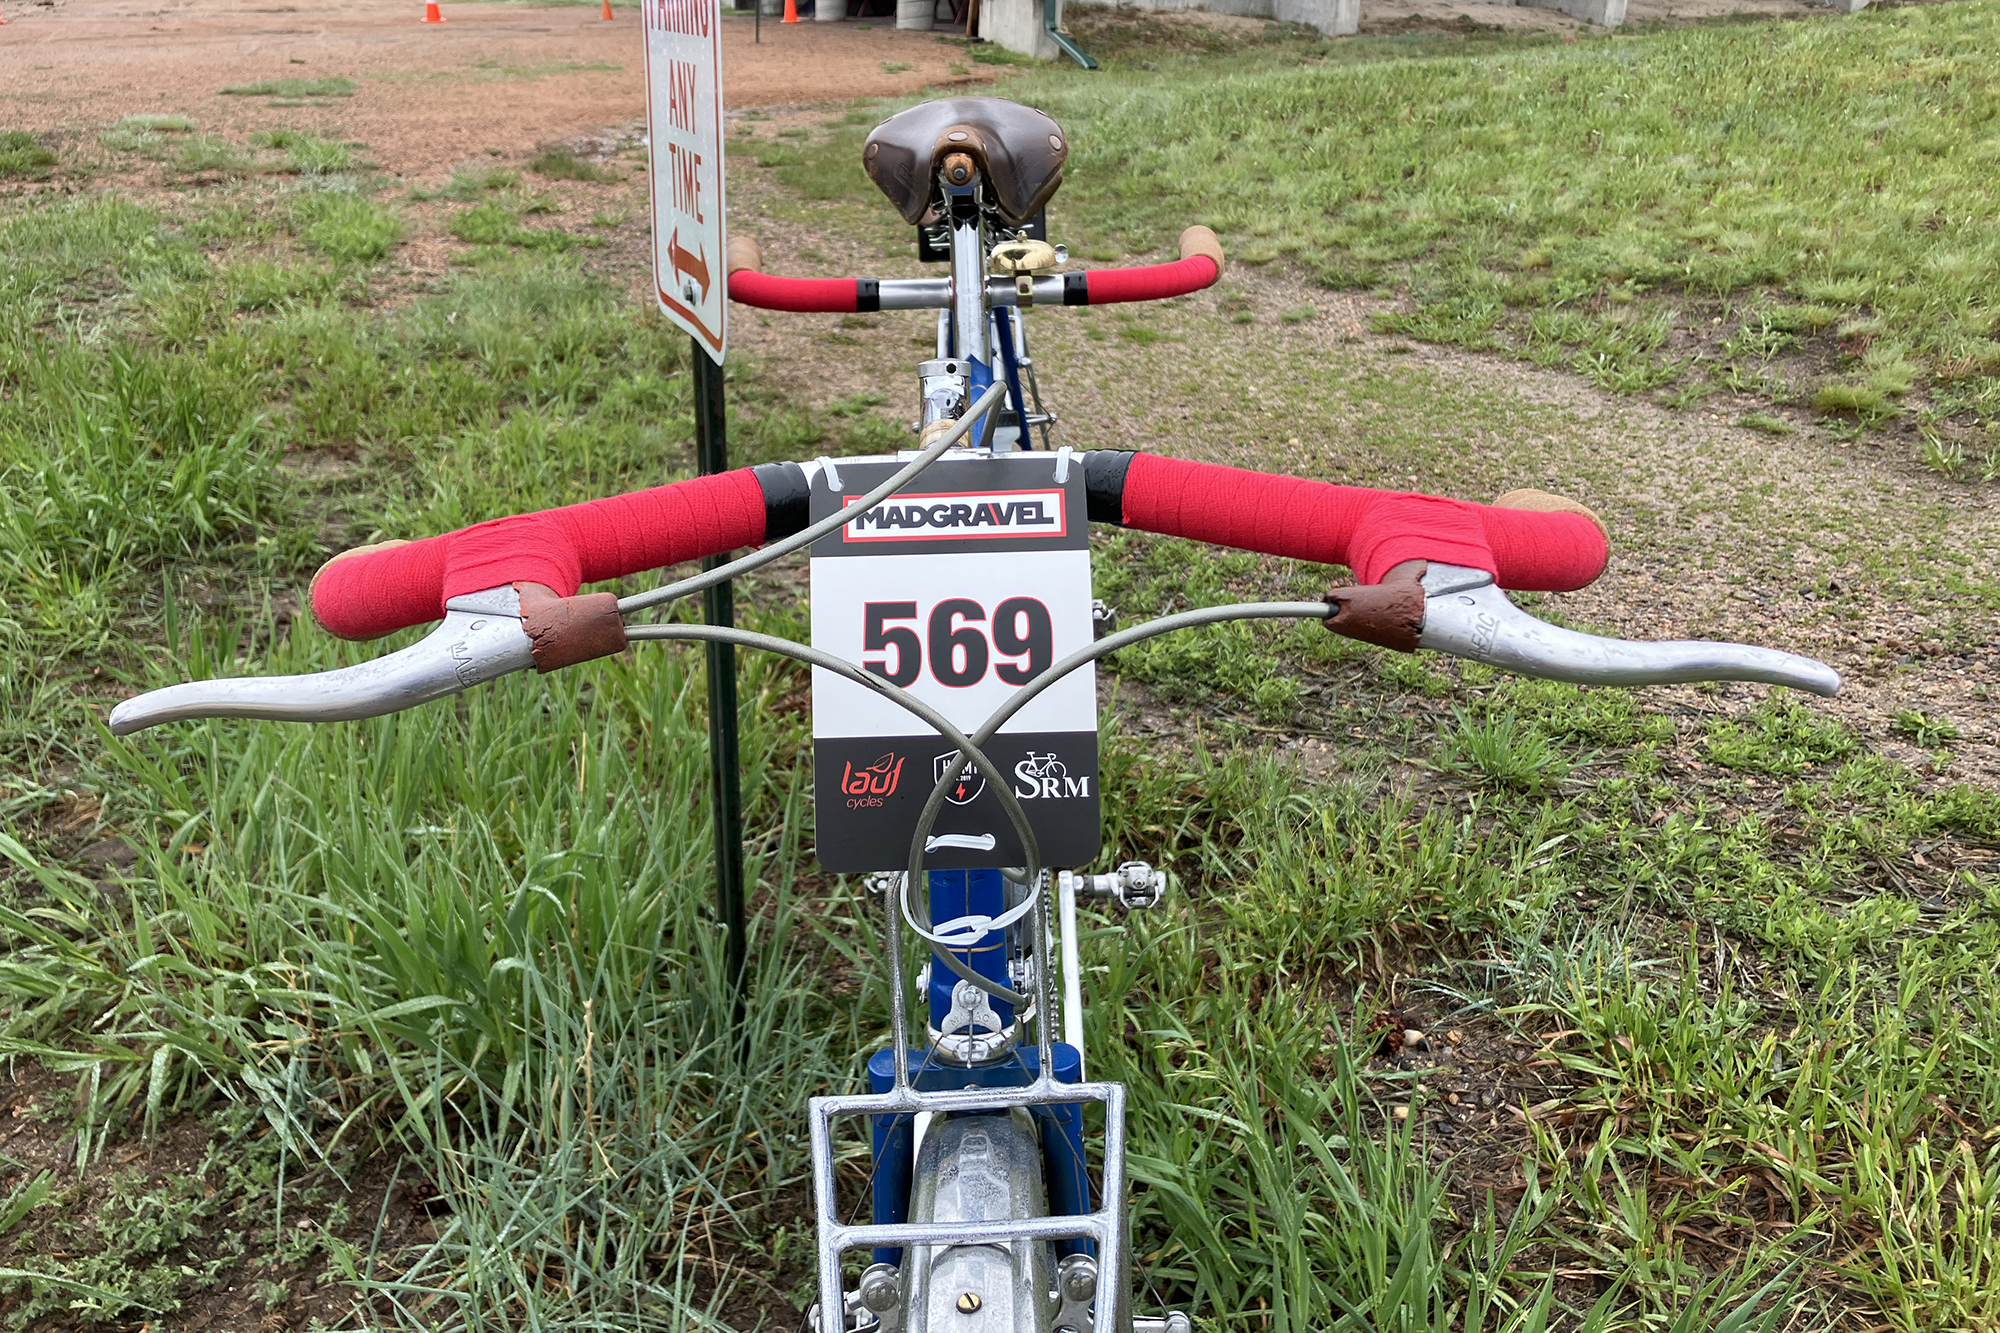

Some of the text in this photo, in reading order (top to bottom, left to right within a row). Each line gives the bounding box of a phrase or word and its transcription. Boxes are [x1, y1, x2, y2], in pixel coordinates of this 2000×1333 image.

[669, 58, 697, 135] ANY
[668, 142, 704, 225] TIME
[856, 501, 1054, 530] MADGRAVEL
[862, 596, 1054, 689] 569
[846, 795, 884, 811] cycles
[1014, 760, 1090, 799] SRM
